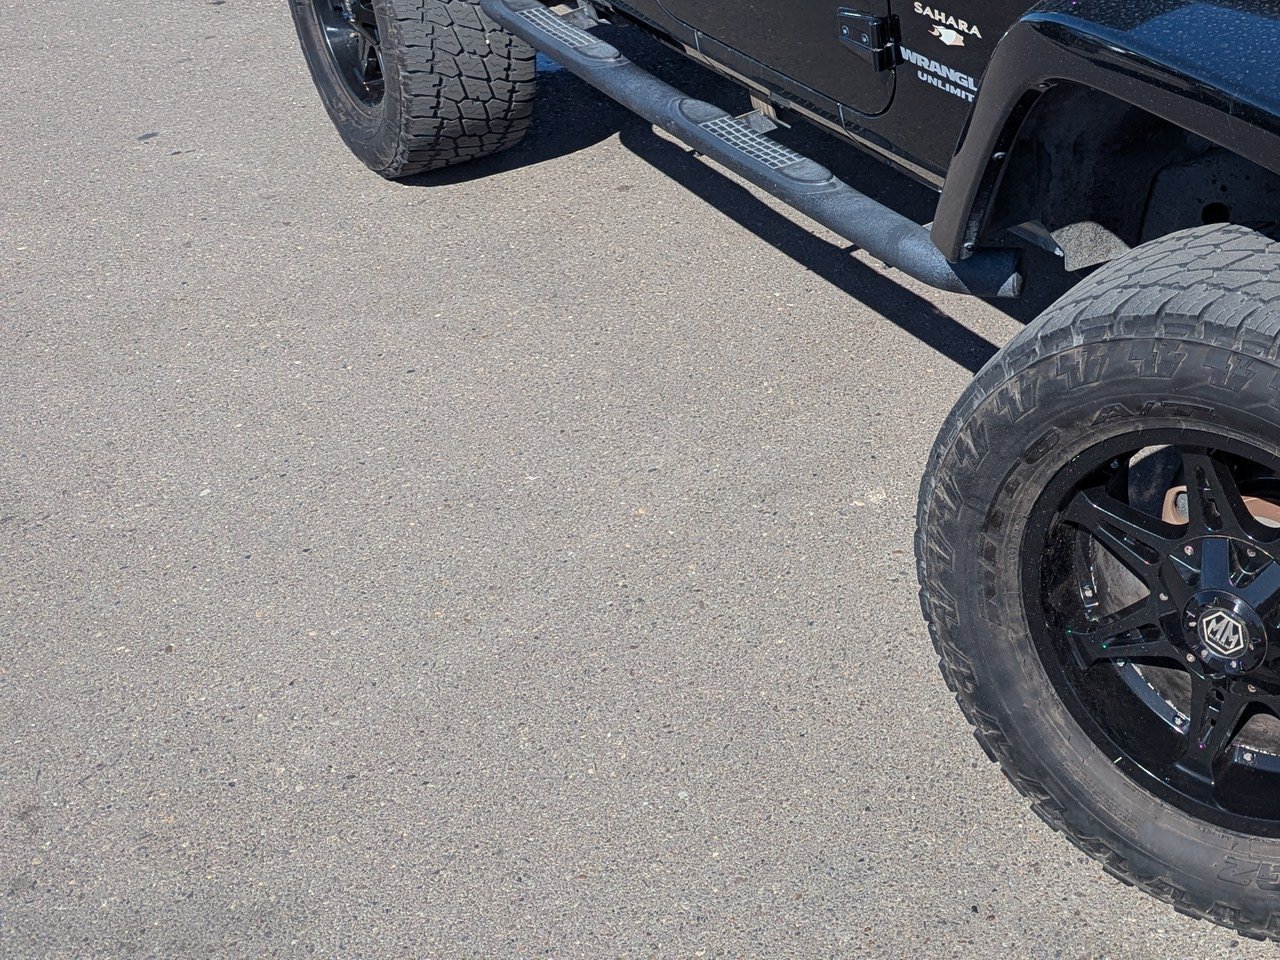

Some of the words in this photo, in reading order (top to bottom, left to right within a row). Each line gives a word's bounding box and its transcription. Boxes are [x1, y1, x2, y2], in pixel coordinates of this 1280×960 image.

[913, 1, 982, 39] SAHARA
[900, 45, 978, 91] WRANGL
[917, 70, 975, 103] UNLIMIT
